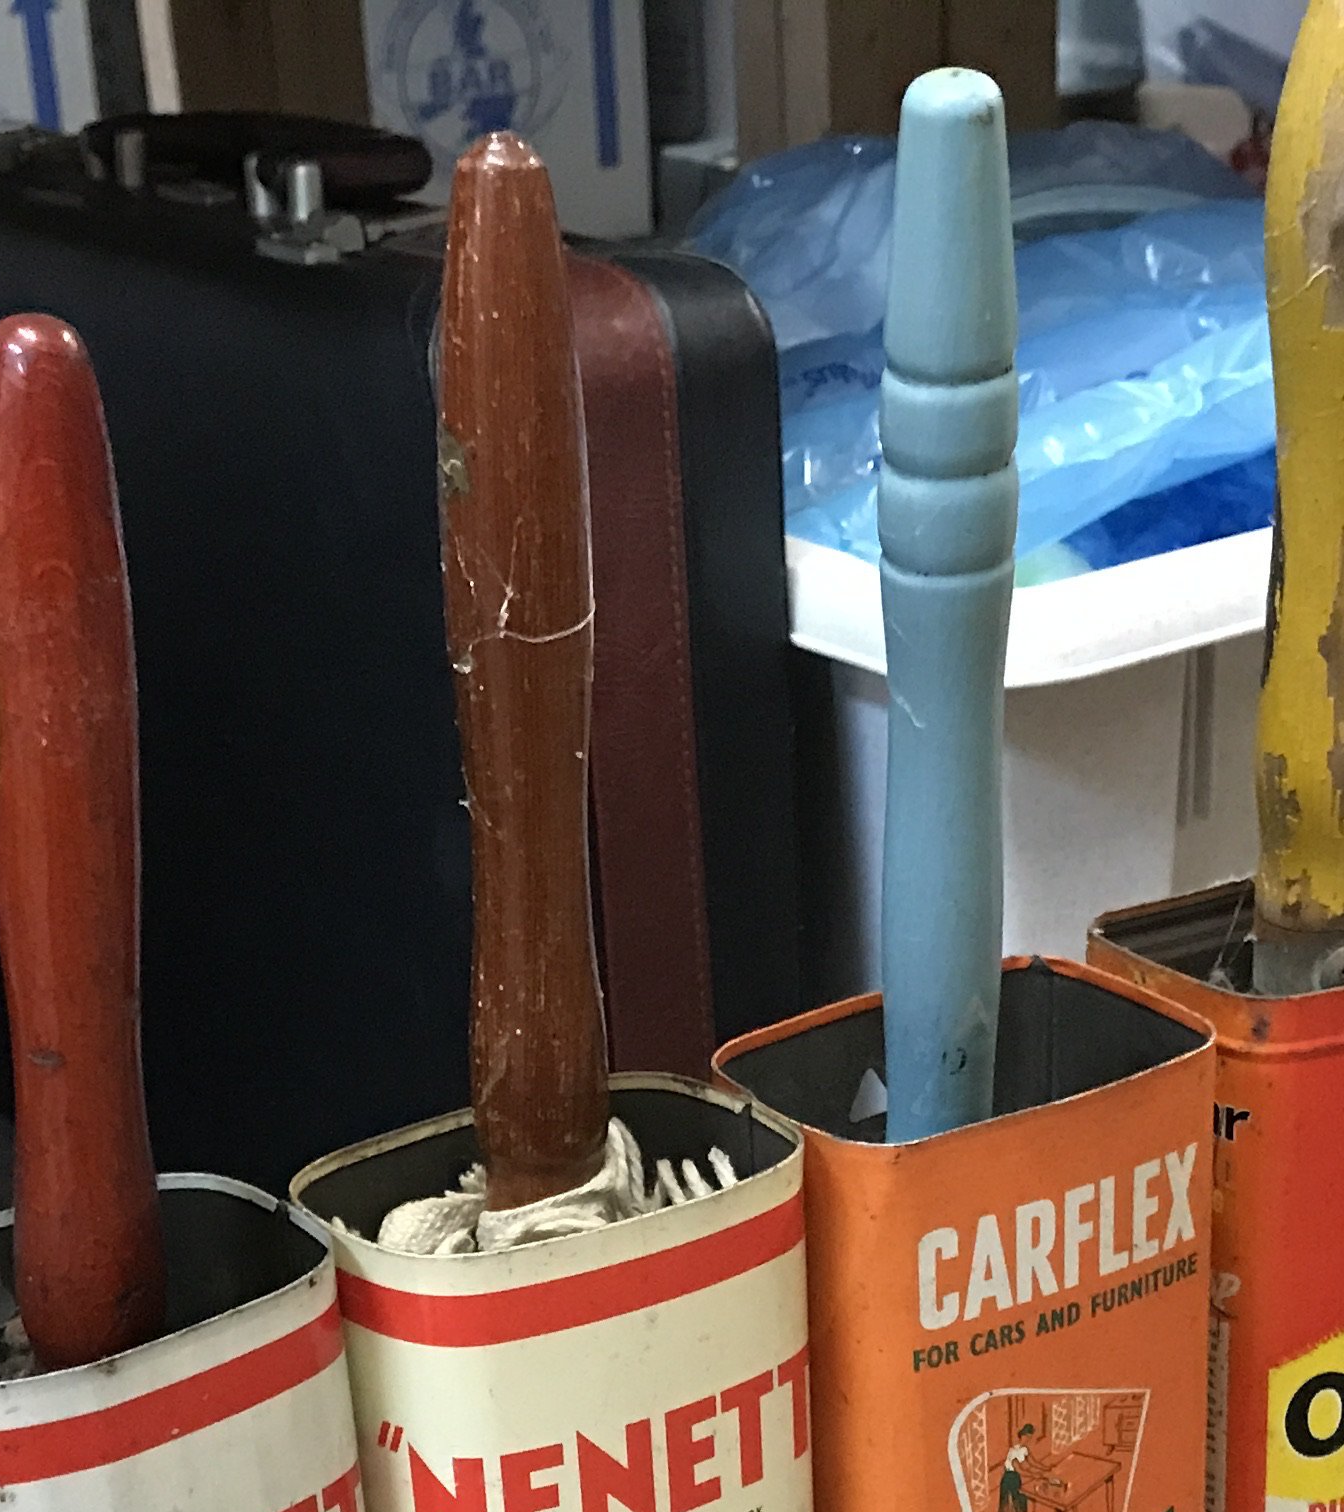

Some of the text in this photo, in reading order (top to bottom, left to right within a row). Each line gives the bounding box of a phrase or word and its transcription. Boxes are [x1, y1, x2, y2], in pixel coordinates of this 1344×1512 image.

[912, 1340, 961, 1373] FOR
[969, 1320, 1026, 1357] CARS
[1035, 1301, 1082, 1337] AND
[1090, 1252, 1199, 1318] FURNITURE
[917, 1141, 1199, 1331] CARFLEX
